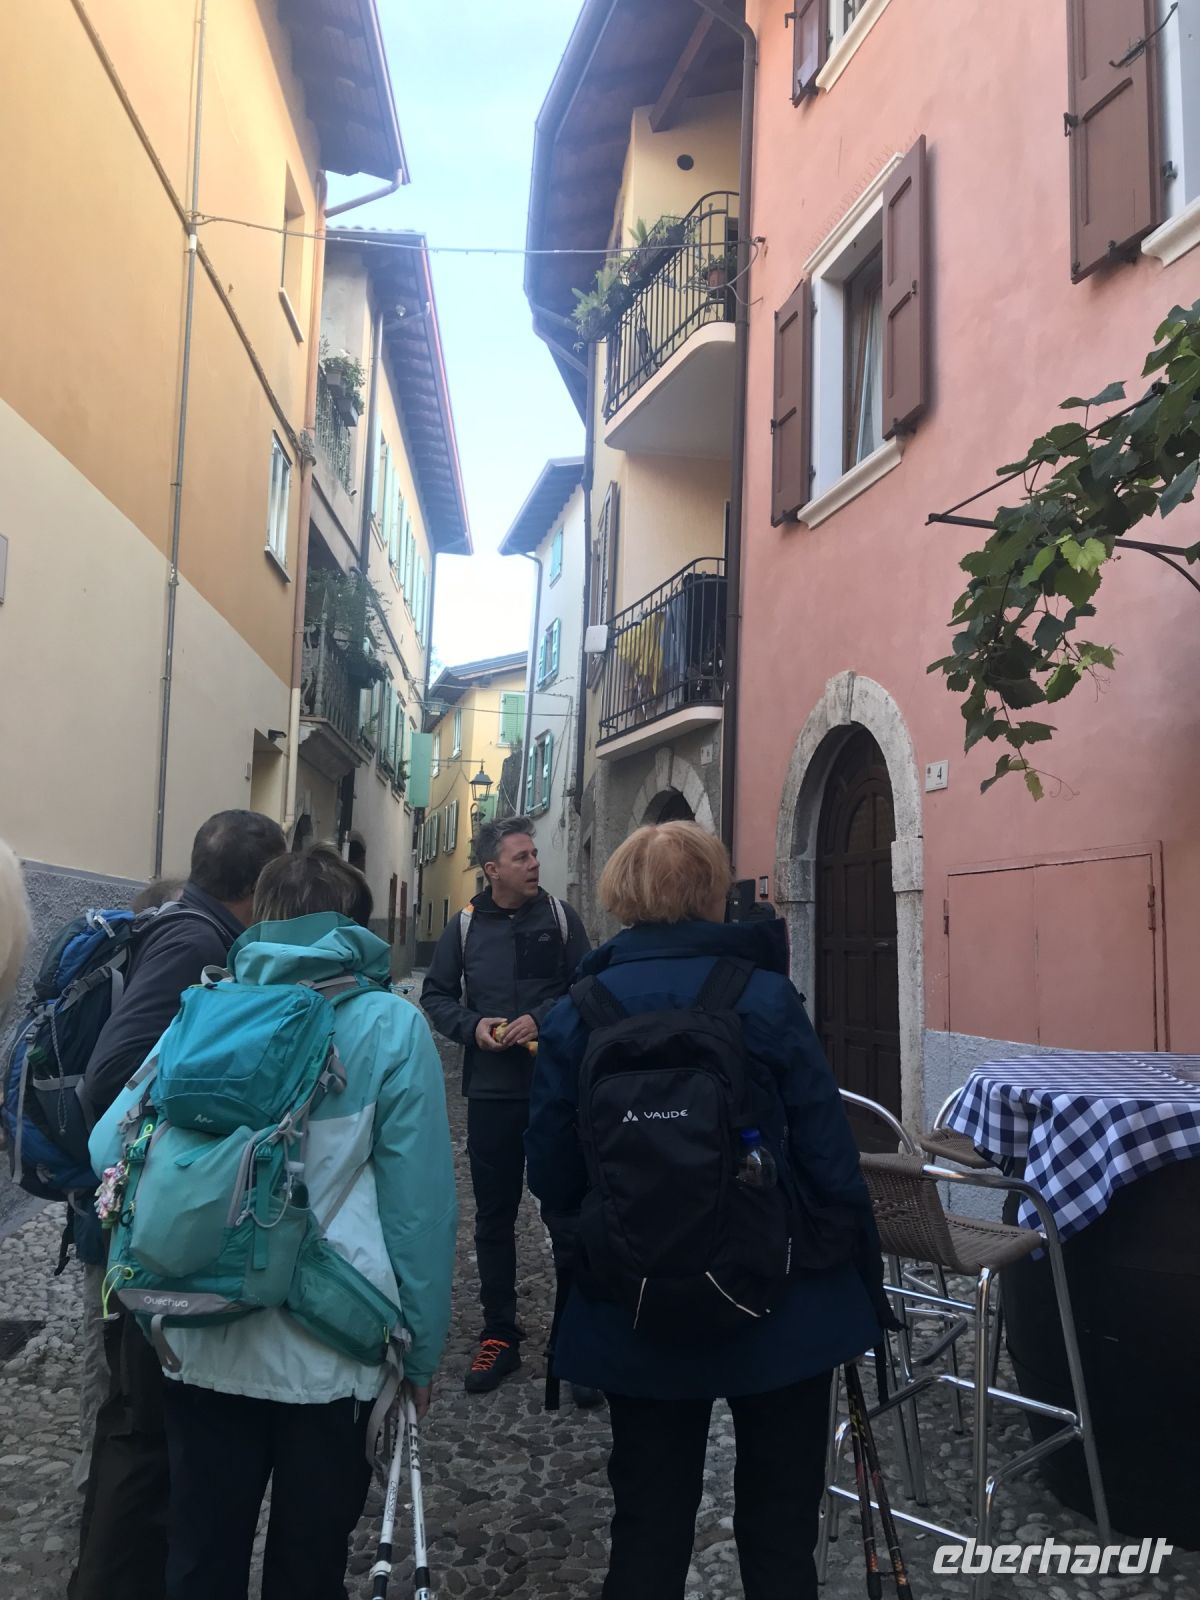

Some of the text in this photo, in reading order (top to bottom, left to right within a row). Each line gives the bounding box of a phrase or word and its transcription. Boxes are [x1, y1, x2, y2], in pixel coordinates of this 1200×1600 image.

[936, 766, 942, 780] 4
[644, 1109, 688, 1119] VAUDE
[144, 1295, 189, 1308] Quechua
[408, 1423, 421, 1471] LEKI
